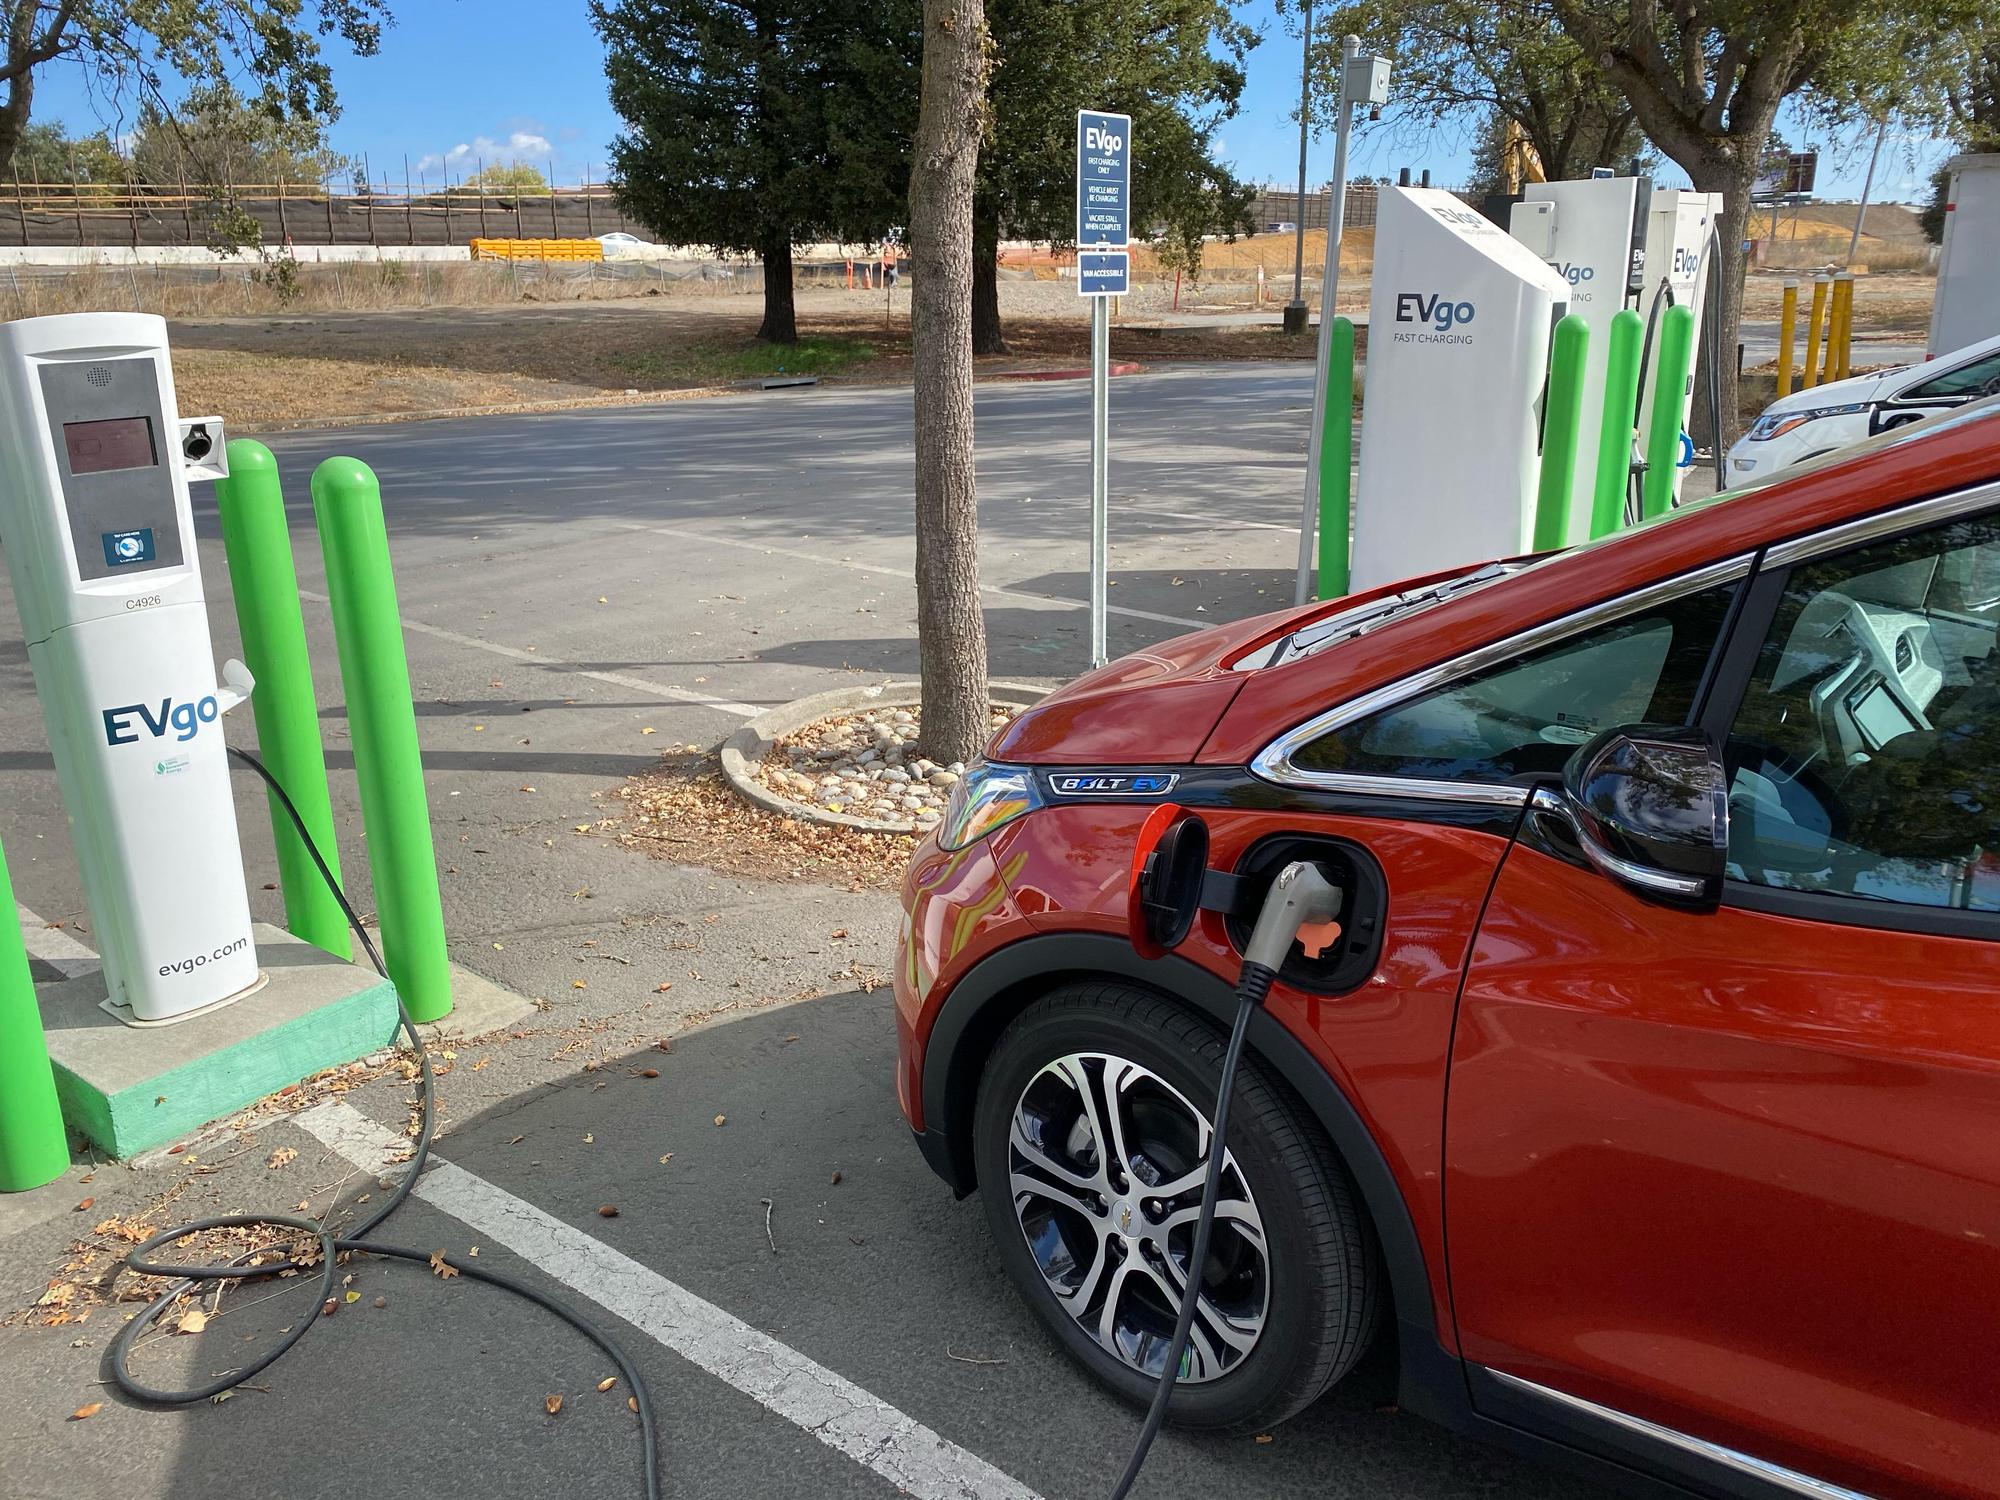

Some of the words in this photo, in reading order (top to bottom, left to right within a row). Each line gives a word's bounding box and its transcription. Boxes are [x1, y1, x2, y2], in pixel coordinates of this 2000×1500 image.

[1086, 127, 1122, 156] EVgo
[1088, 157, 1098, 165] FAST
[1098, 158, 1120, 167] CHARGING
[1088, 186, 1106, 194] VEHICLE
[1095, 195, 1118, 203] CHARGING
[1089, 214, 1104, 222] VACATE
[1105, 215, 1118, 223] STALL
[1431, 207, 1483, 229] EVgo
[1099, 223, 1122, 231] COMPLETE
[1674, 247, 1699, 280] EVgo
[1083, 269, 1093, 277] VAN
[1093, 269, 1124, 277] ACCESSIBLE
[1396, 293, 1476, 332] EVgo
[1394, 333, 1416, 343] FAST
[1419, 334, 1473, 345] CHARGING
[126, 594, 161, 610] C4926
[102, 695, 218, 746] EVgo
[1061, 778, 1127, 790] BOLT
[1132, 777, 1167, 790] EV
[158, 937, 247, 977] evgo.com
